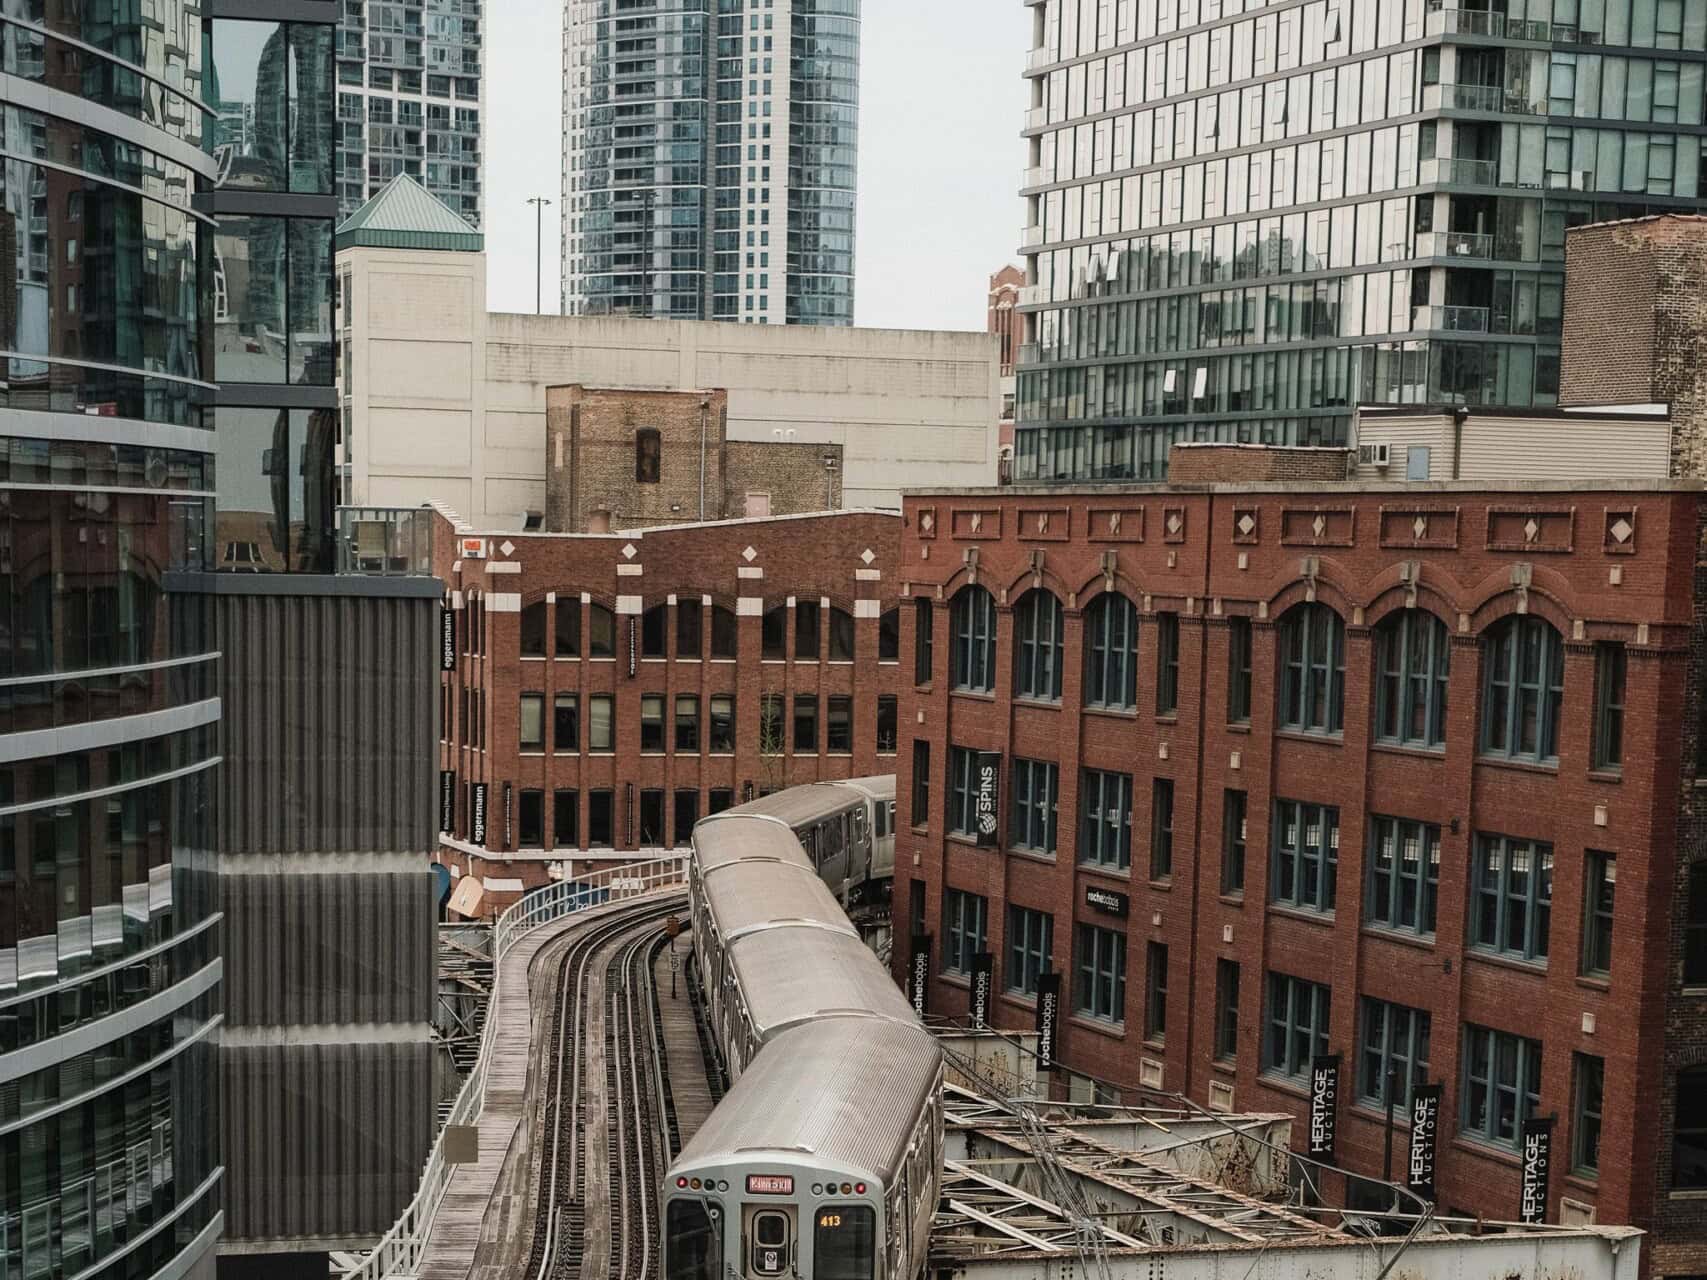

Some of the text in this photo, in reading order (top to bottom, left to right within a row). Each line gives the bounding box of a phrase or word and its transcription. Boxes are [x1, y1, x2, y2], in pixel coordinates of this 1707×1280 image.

[444, 613, 454, 668] eggersmann
[475, 786, 484, 841] eggersmann
[980, 766, 993, 811] SPINS
[1312, 1069, 1328, 1152] HERITAGE
[1325, 1068, 1336, 1151] AUCTIONS
[1411, 1098, 1428, 1185] HERITAGE
[1424, 1097, 1437, 1184] AUCTIONS
[1522, 1133, 1539, 1224] HERITAGE
[1536, 1133, 1548, 1226] AUCTIONS
[820, 1215, 841, 1227] 413
